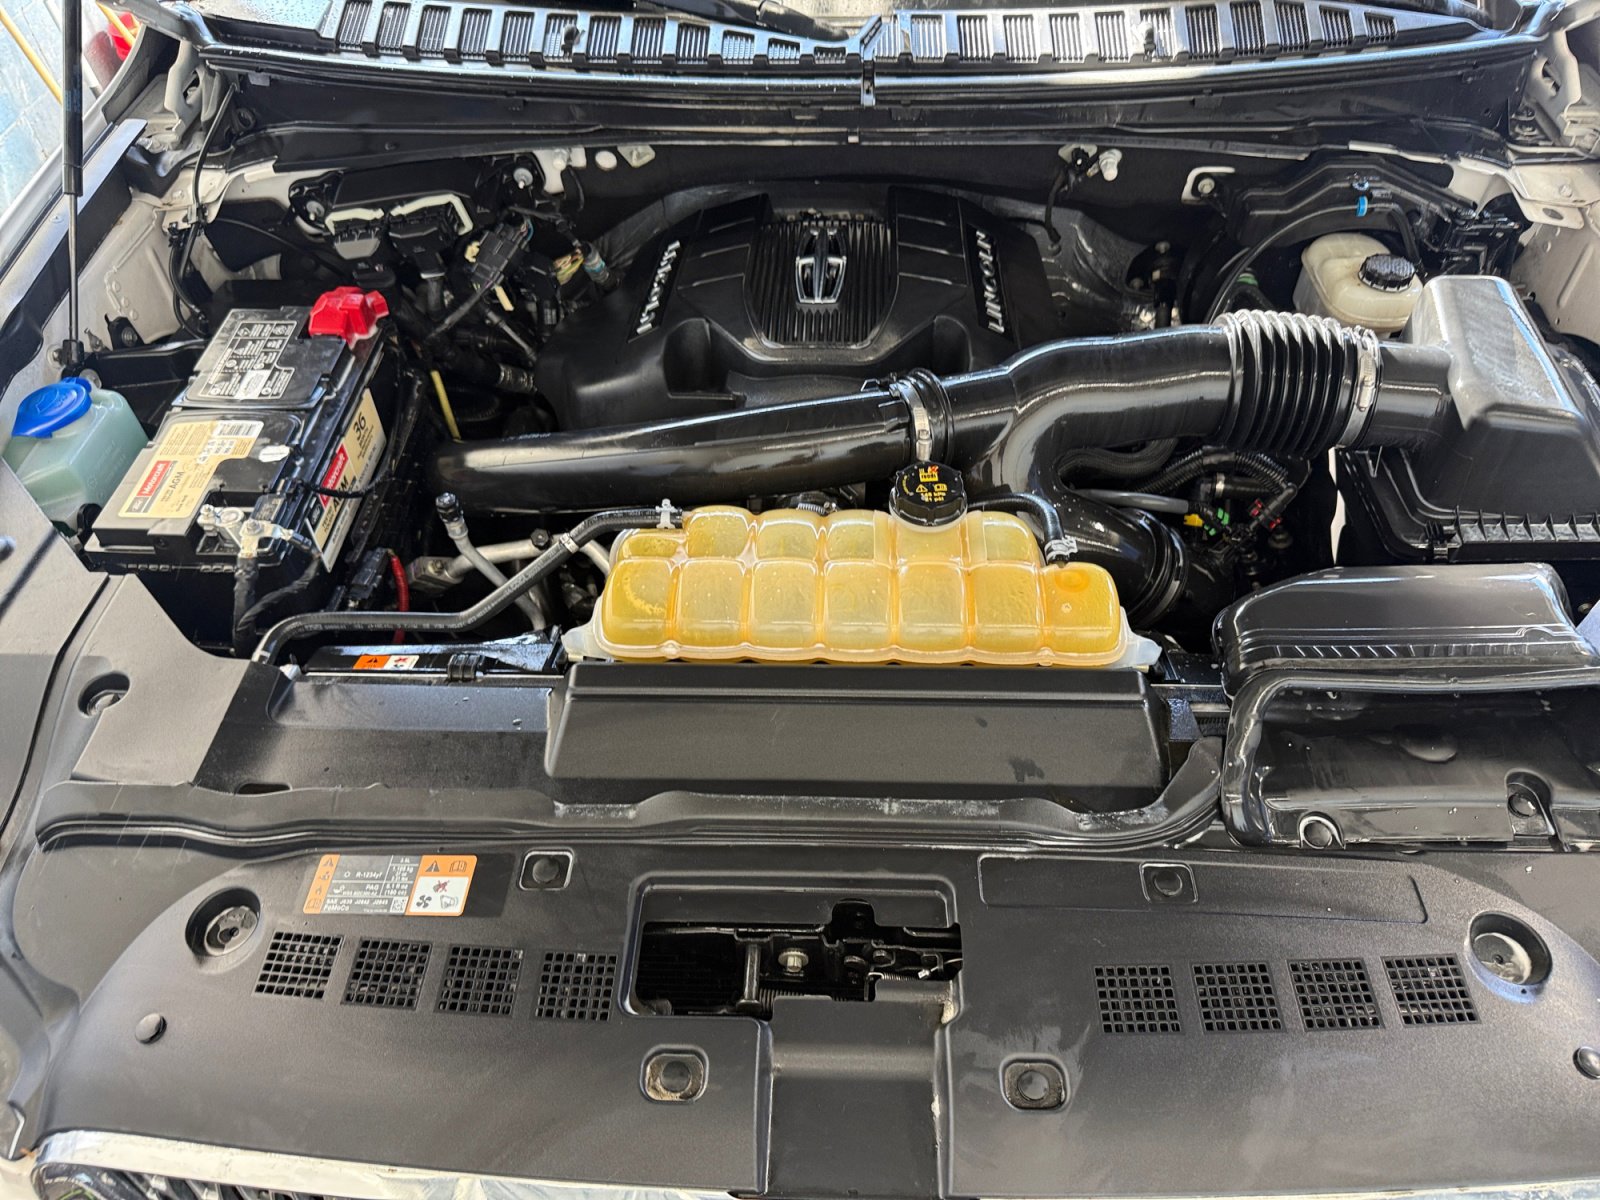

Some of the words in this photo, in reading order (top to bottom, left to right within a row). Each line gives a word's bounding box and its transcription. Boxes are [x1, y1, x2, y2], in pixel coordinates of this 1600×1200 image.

[636, 240, 681, 335] LINCOLN
[976, 229, 1005, 334] LINCOLN
[353, 411, 367, 441] 36
[142, 462, 167, 496] Motorcraft
[171, 471, 185, 490] AGM
[355, 871, 382, 879] R-1234yf
[322, 904, 350, 912] FoMoCo
